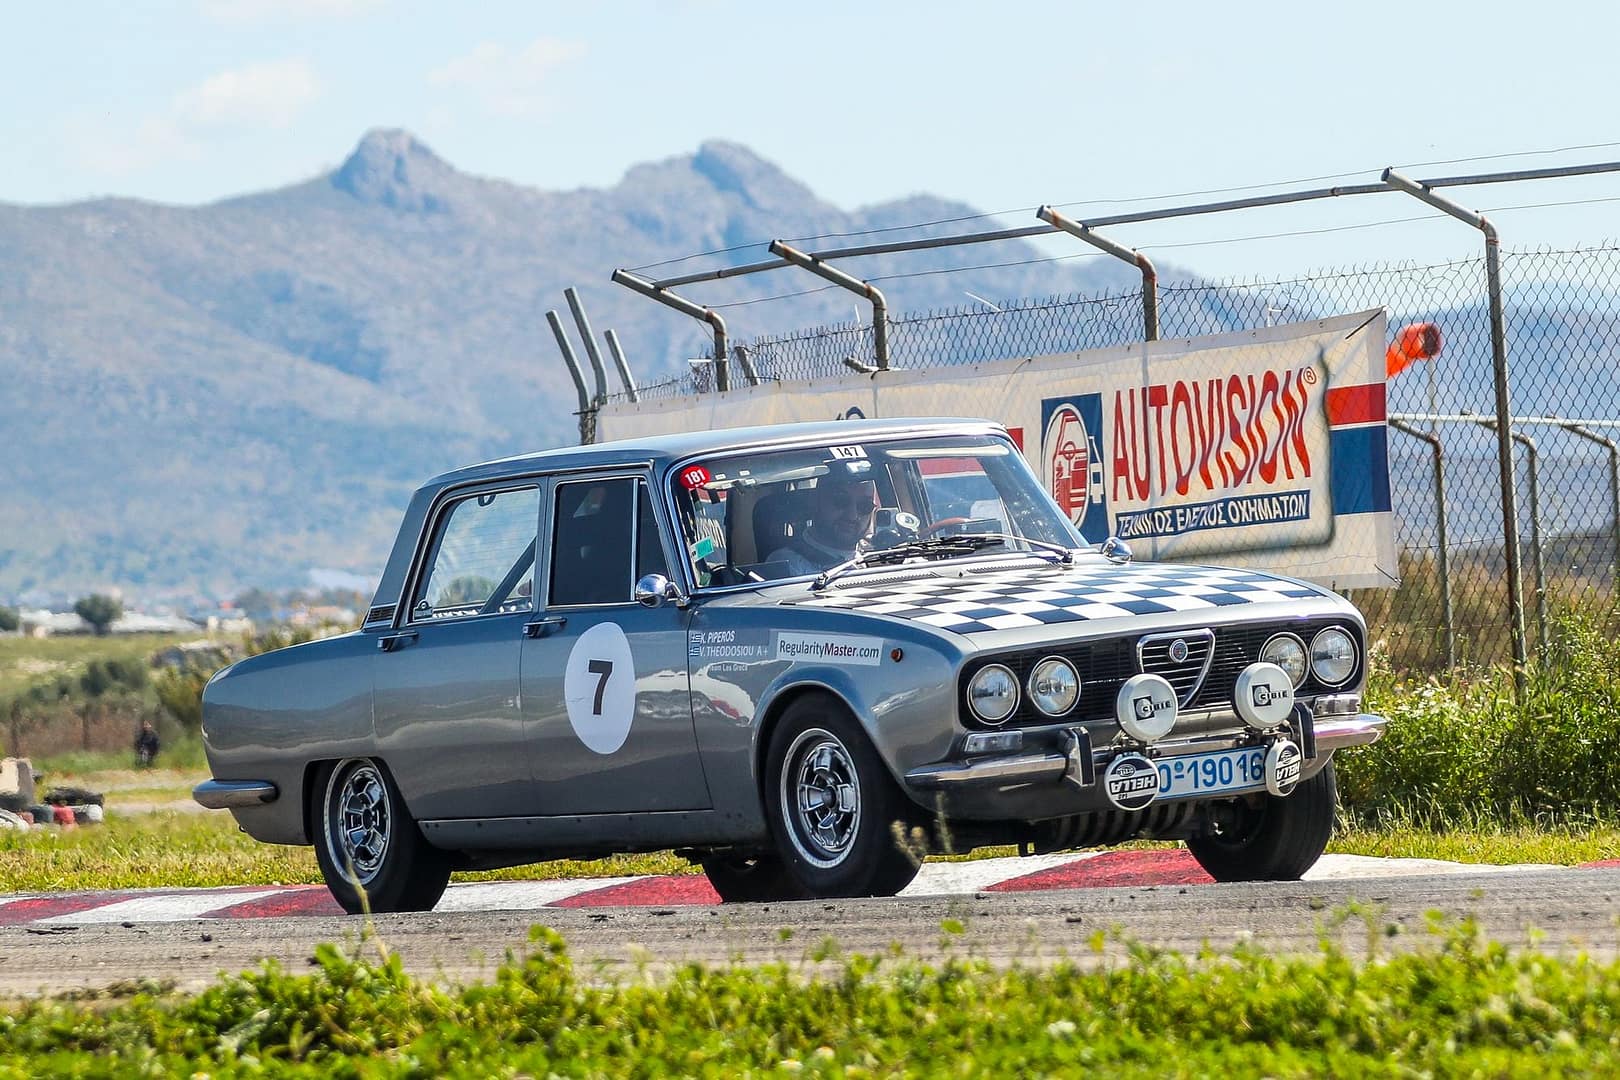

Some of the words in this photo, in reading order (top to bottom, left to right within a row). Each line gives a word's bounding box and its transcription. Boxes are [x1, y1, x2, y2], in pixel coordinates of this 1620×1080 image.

[838, 447, 861, 458] 147
[684, 469, 706, 484] 181
[1227, 494, 1308, 522] ΟΧΗΜΑΤΩΝ
[707, 630, 736, 644] PIPEROS
[707, 645, 754, 657] THEODOSIOU
[779, 639, 880, 659] RegularityMaster.com
[588, 658, 613, 716] 7
[1110, 774, 1156, 794] HELLA
